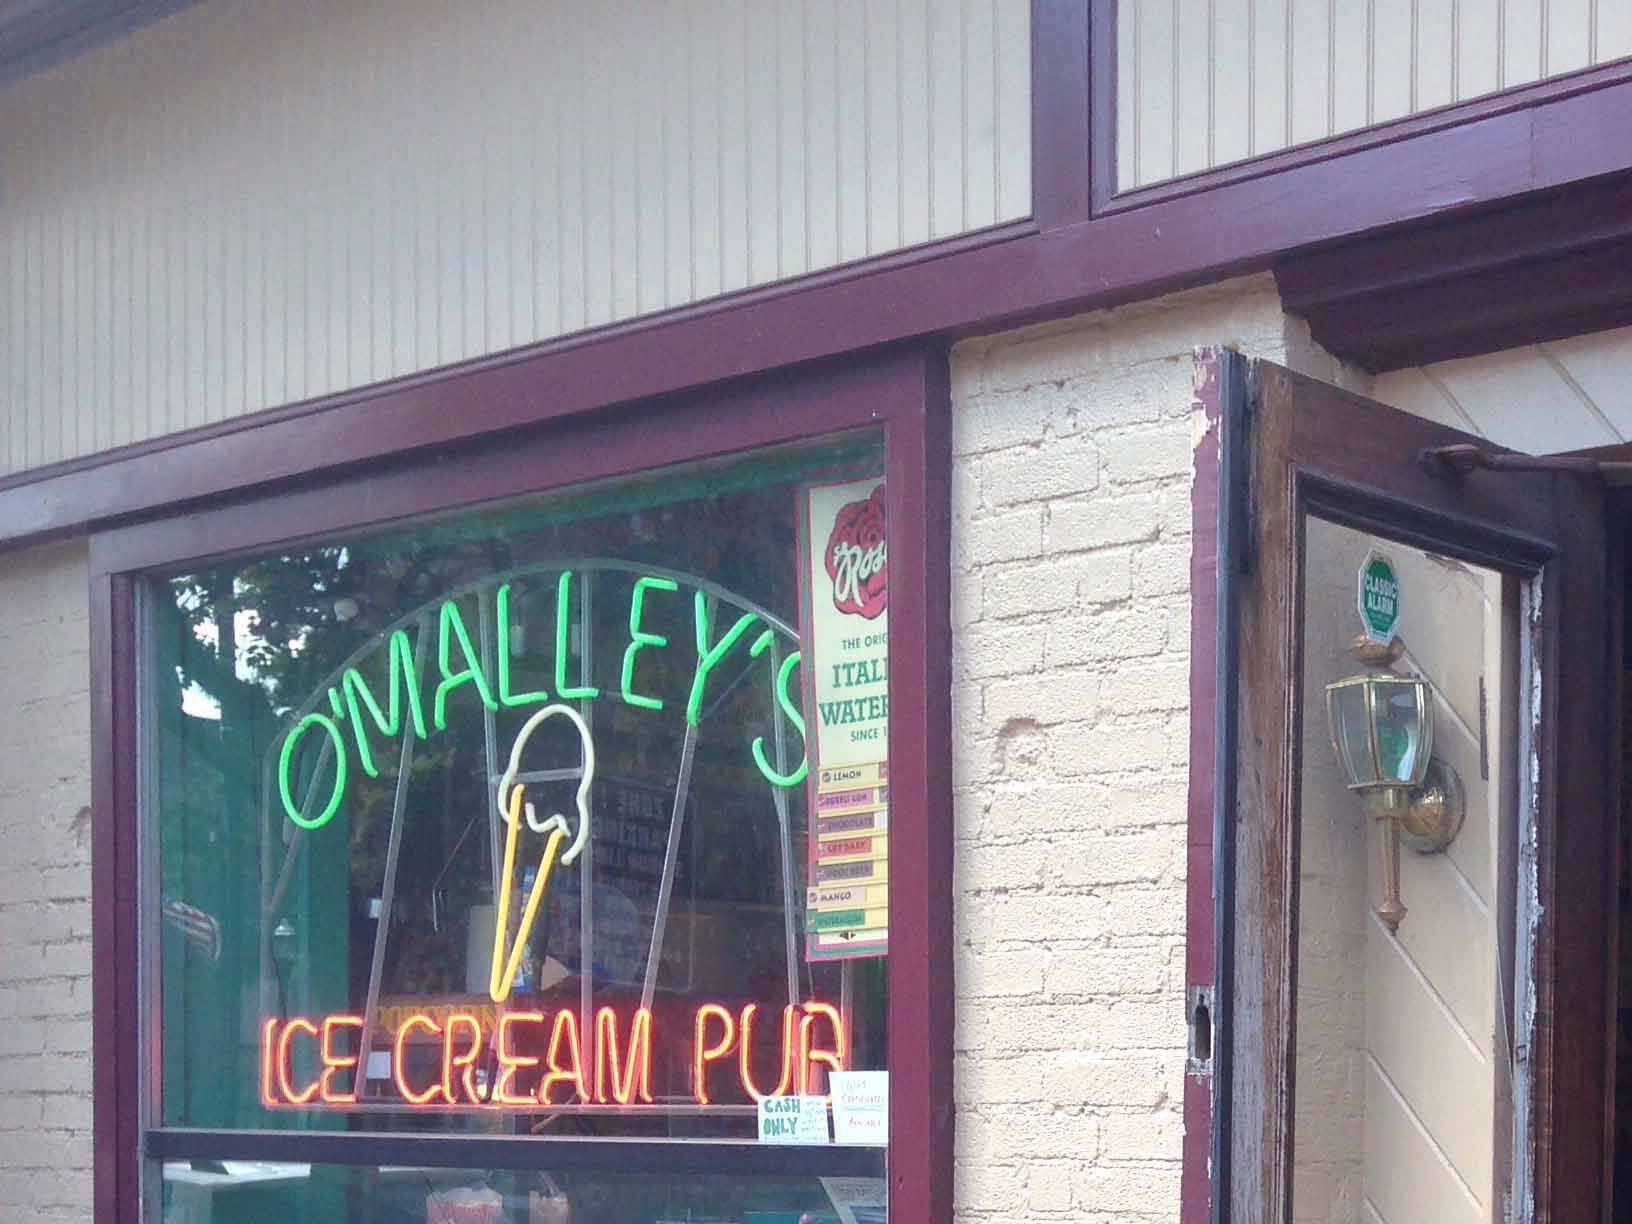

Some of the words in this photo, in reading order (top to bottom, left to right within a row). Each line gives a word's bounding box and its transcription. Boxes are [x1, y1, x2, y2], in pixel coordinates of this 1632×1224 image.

[841, 638, 861, 650] THE
[279, 569, 808, 830] O'MALLEY'S
[850, 729, 879, 742] SINCE
[832, 771, 862, 782] LEMON
[820, 891, 852, 902] MANGO
[263, 1015, 364, 1106] ICE
[394, 1006, 654, 1106] CREAM
[764, 1098, 800, 1114] CASH
[763, 1117, 798, 1136] ONLY
